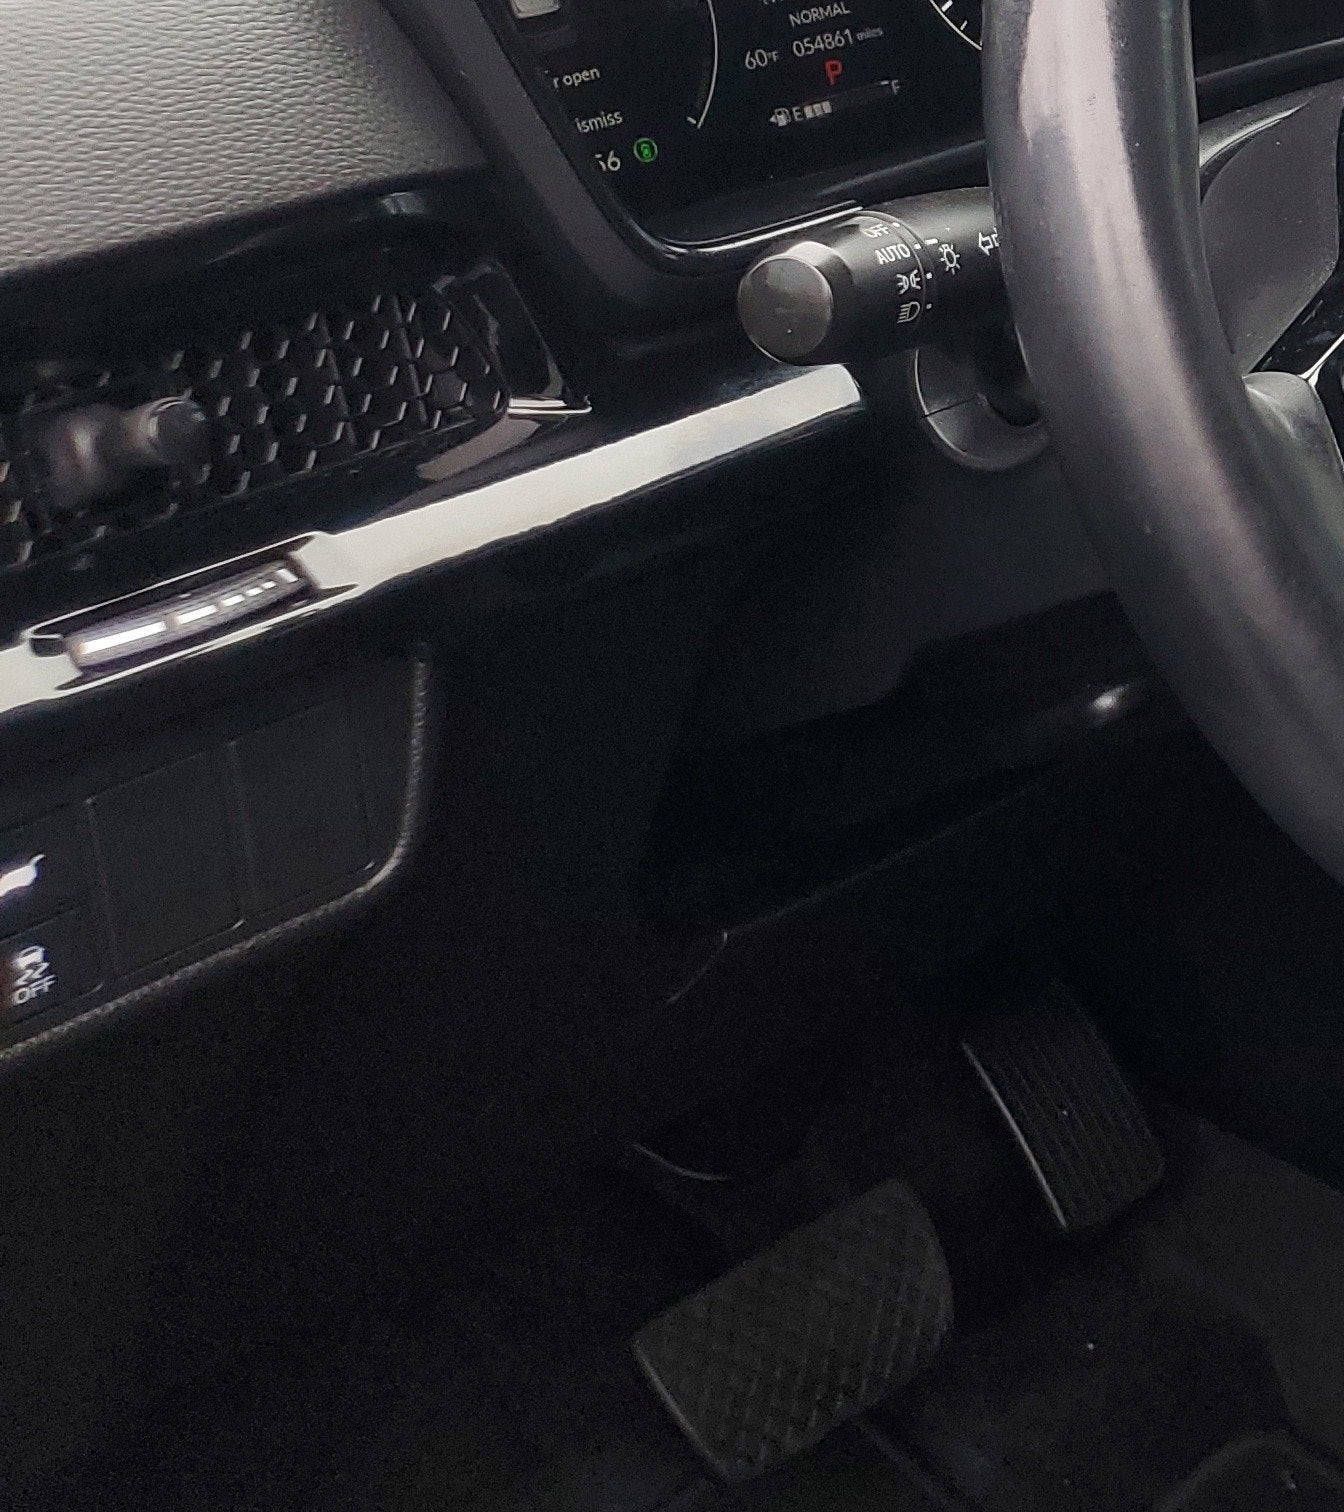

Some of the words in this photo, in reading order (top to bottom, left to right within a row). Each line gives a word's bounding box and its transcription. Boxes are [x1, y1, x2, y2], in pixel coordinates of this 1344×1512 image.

[788, 1, 851, 28] NORMAL
[792, 28, 854, 58] 054861
[562, 67, 601, 87] open
[825, 59, 843, 86] P
[874, 242, 911, 266] AUTO
[12, 974, 57, 1005] OFF
